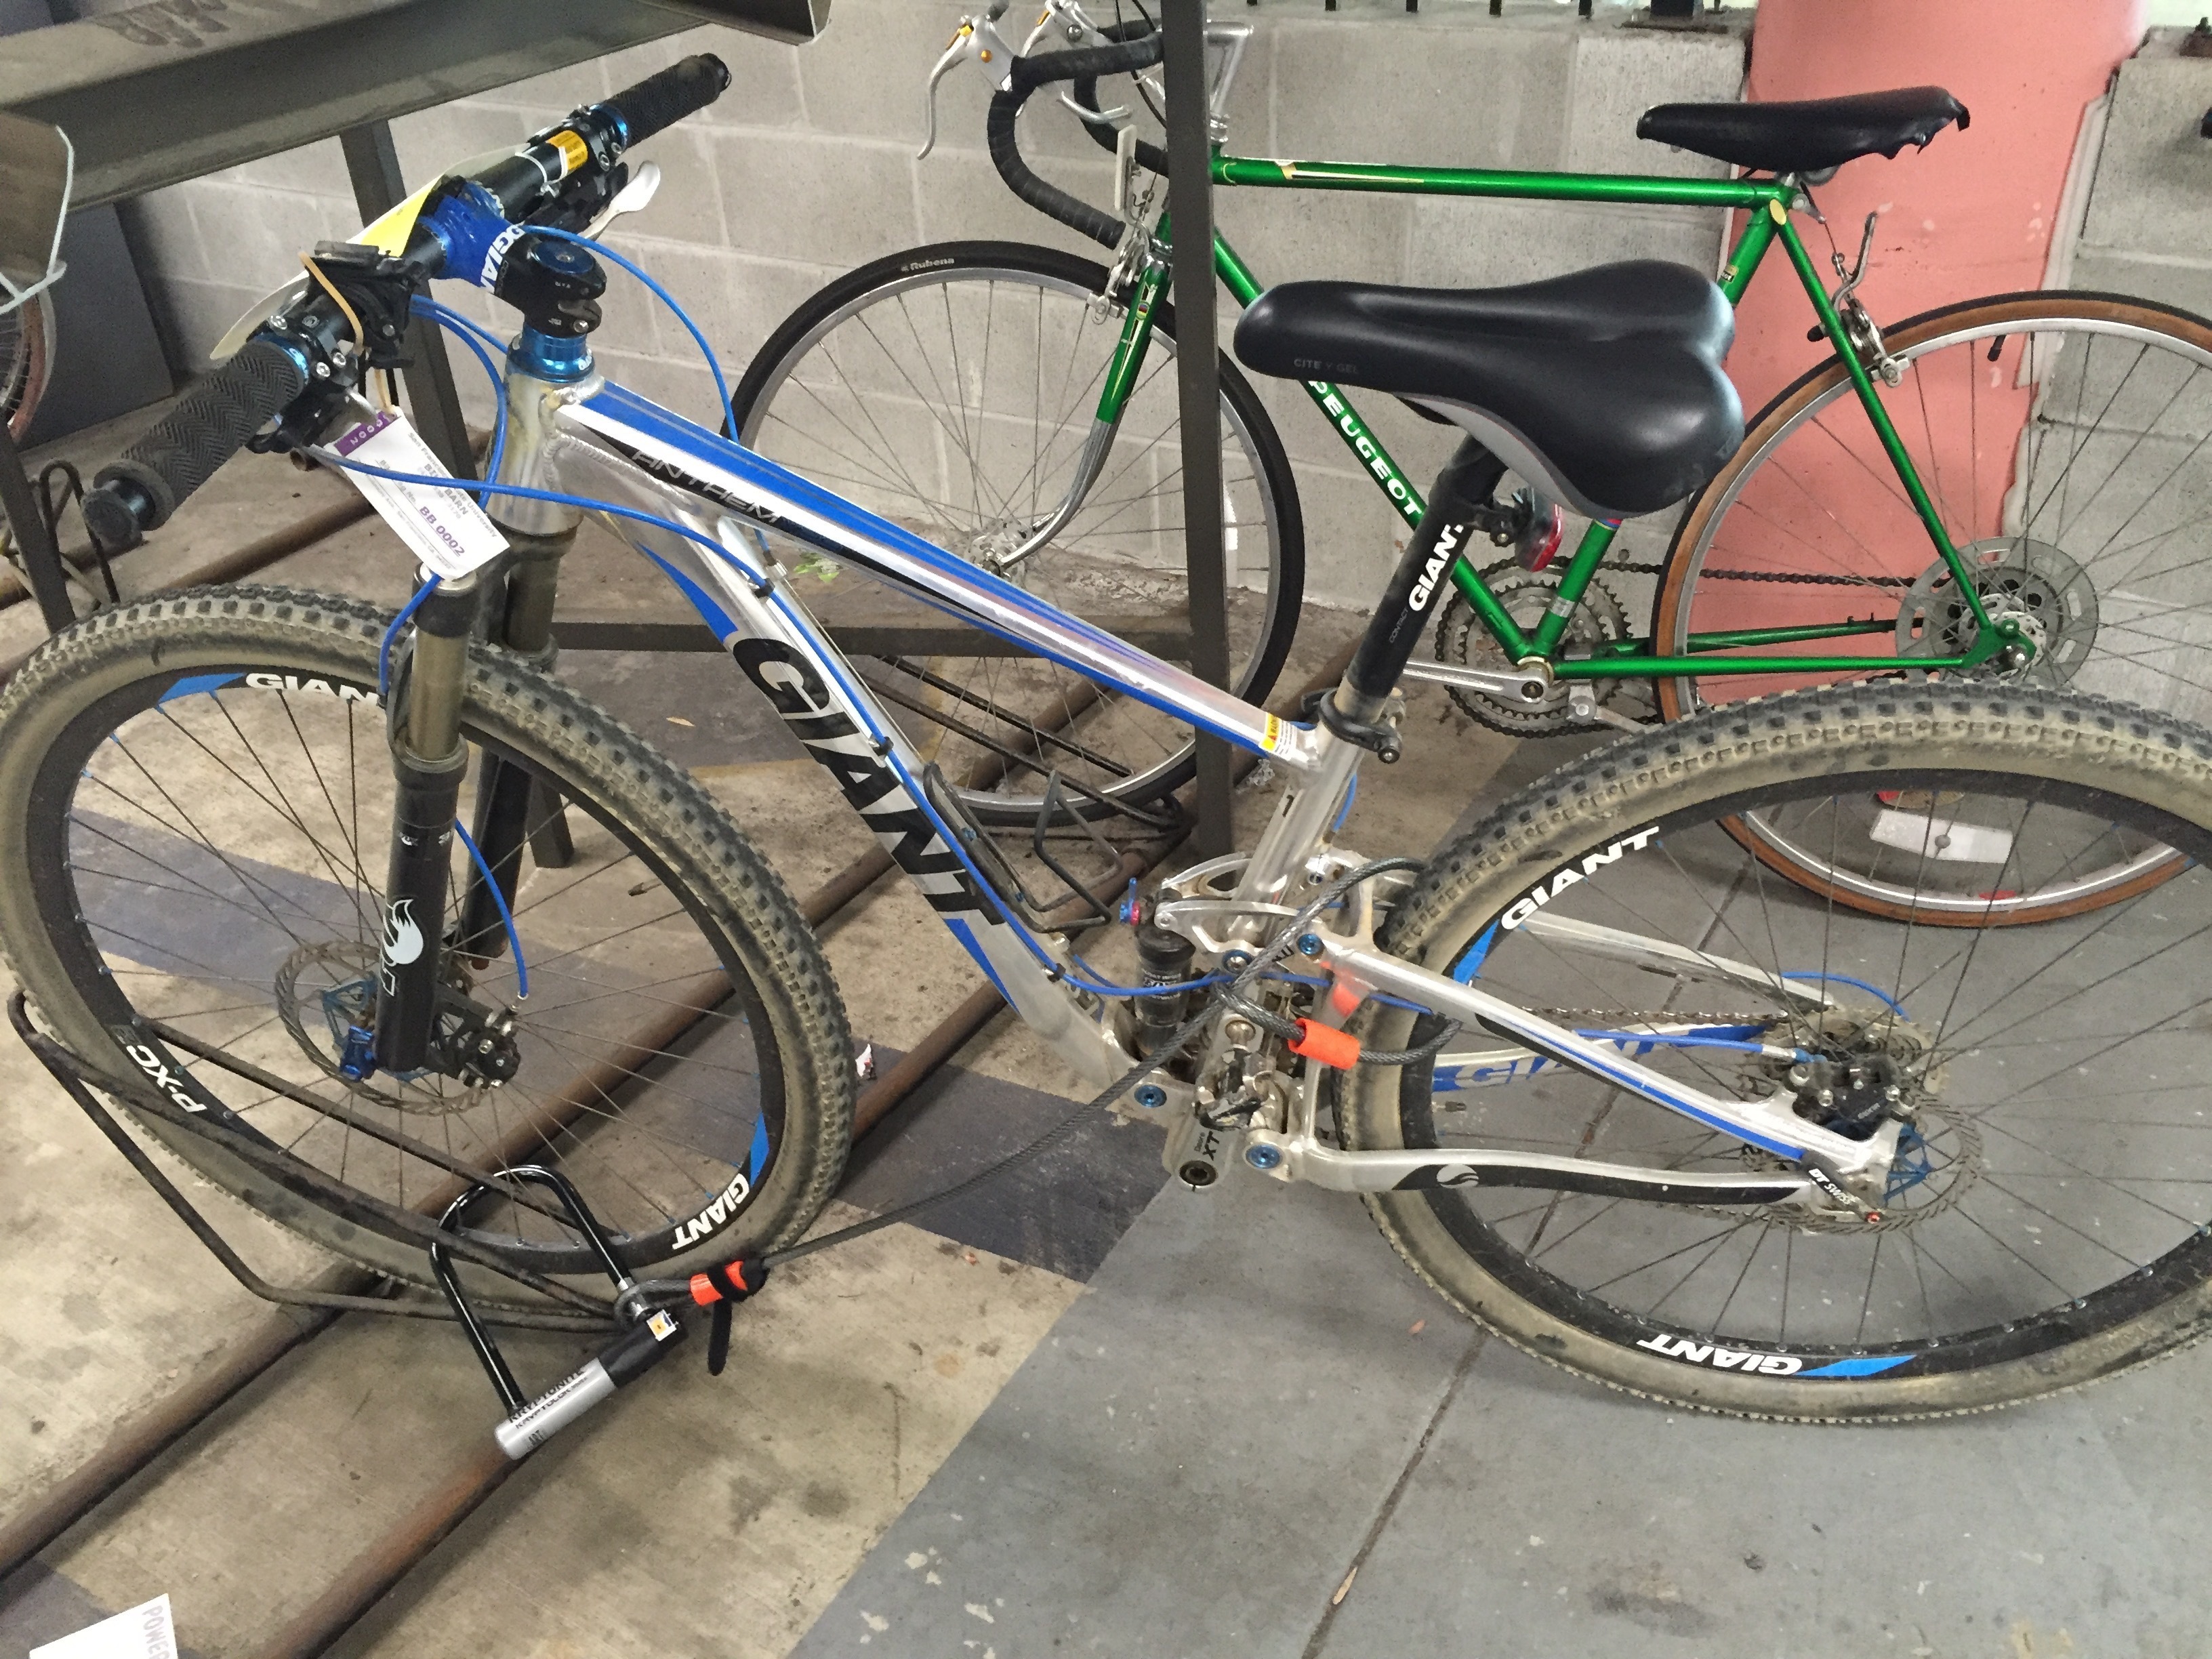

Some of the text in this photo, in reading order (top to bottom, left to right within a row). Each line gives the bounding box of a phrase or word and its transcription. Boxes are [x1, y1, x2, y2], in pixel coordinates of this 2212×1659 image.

[480, 230, 514, 295] GIAN
[910, 258, 955, 270] Rubena
[1308, 380, 1424, 516] PEUGEOT
[443, 488, 469, 516] BARN
[632, 449, 780, 523] ANTHEM
[419, 506, 438, 525] BB
[436, 525, 466, 556] 0002
[467, 501, 497, 537] University
[1389, 607, 1408, 643] CONTACT
[245, 673, 380, 706] GIAN
[733, 638, 1006, 926] GIANT
[1501, 826, 1660, 930] GIANT
[126, 1045, 207, 1113] P-XC
[1202, 1130, 1220, 1162] XT
[1808, 1168, 1830, 1183] DT
[671, 1172, 750, 1250] GIANT
[1636, 1333, 1803, 1376] GIANT
